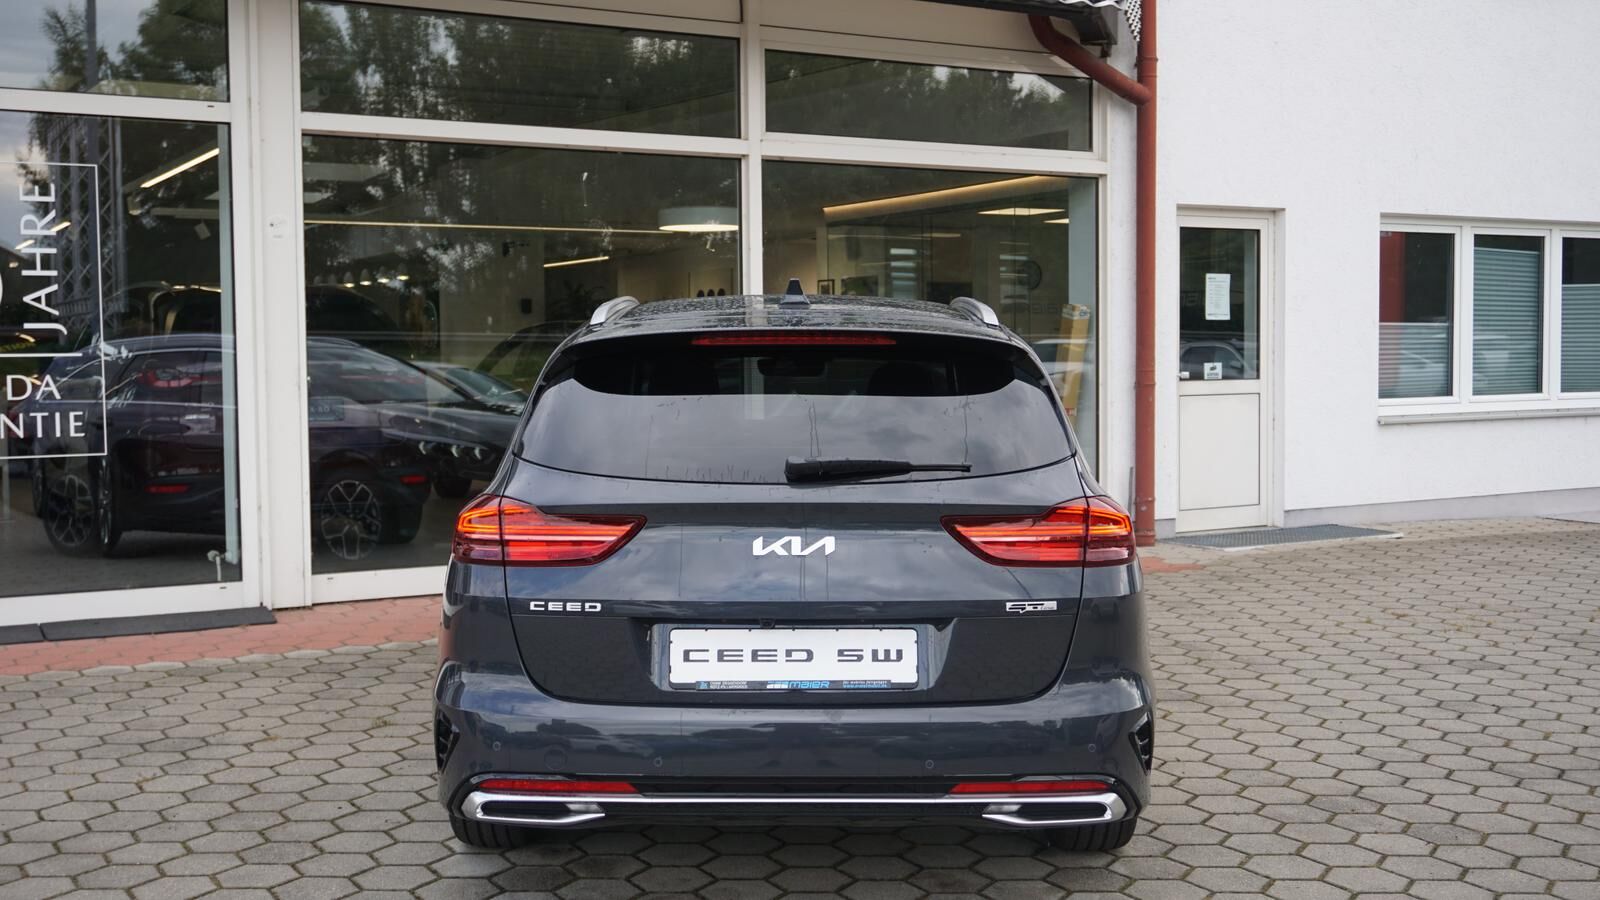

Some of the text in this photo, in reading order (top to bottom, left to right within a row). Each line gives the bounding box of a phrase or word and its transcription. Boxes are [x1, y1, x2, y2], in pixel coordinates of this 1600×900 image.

[19, 183, 67, 336] JAHRE
[0, 411, 86, 439] NTIE
[752, 535, 835, 556] KIA
[529, 601, 602, 612] CEED
[682, 649, 903, 663] CEED SW
